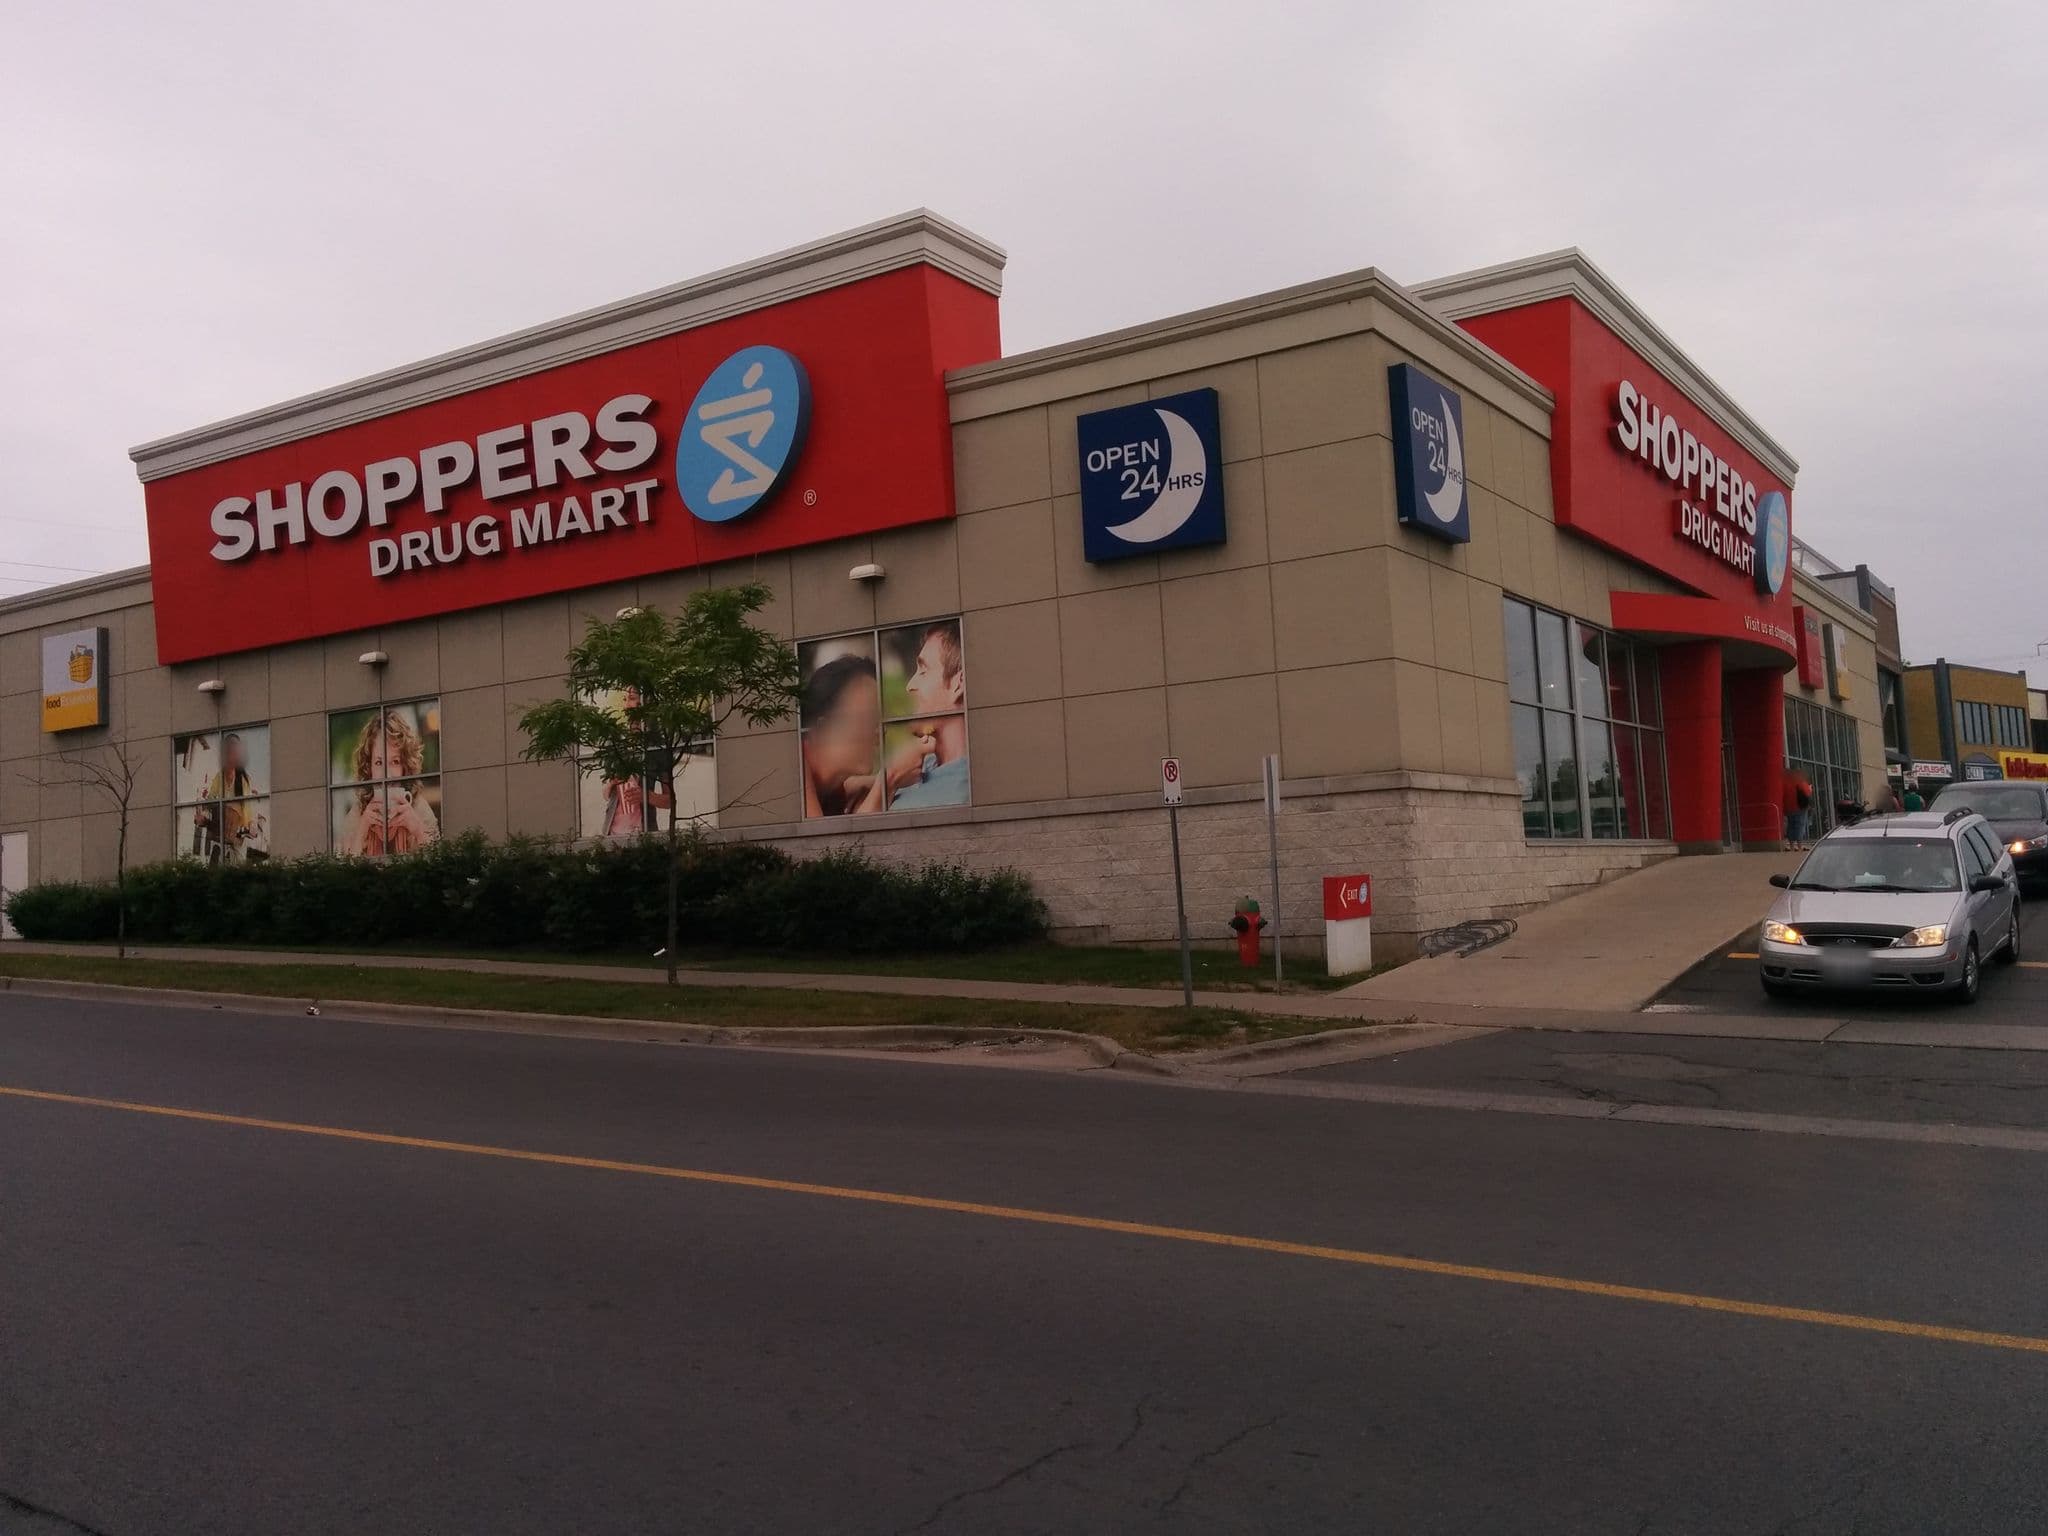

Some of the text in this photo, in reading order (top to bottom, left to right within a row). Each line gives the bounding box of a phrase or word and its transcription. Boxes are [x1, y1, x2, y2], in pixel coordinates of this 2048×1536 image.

[1412, 407, 1445, 443] OPEN
[1087, 438, 1160, 472] OPEN
[1428, 441, 1446, 477] 24
[1617, 380, 1757, 536] SHOPPERS
[210, 394, 658, 561] SHOPPERS
[1120, 464, 1204, 500] 24 HRS
[369, 478, 659, 577] DRUG MART
[1682, 500, 1757, 577] DRUG MART
[1744, 615, 1760, 633] Visit
[46, 697, 61, 710] food
[1347, 888, 1358, 901] EXIT
